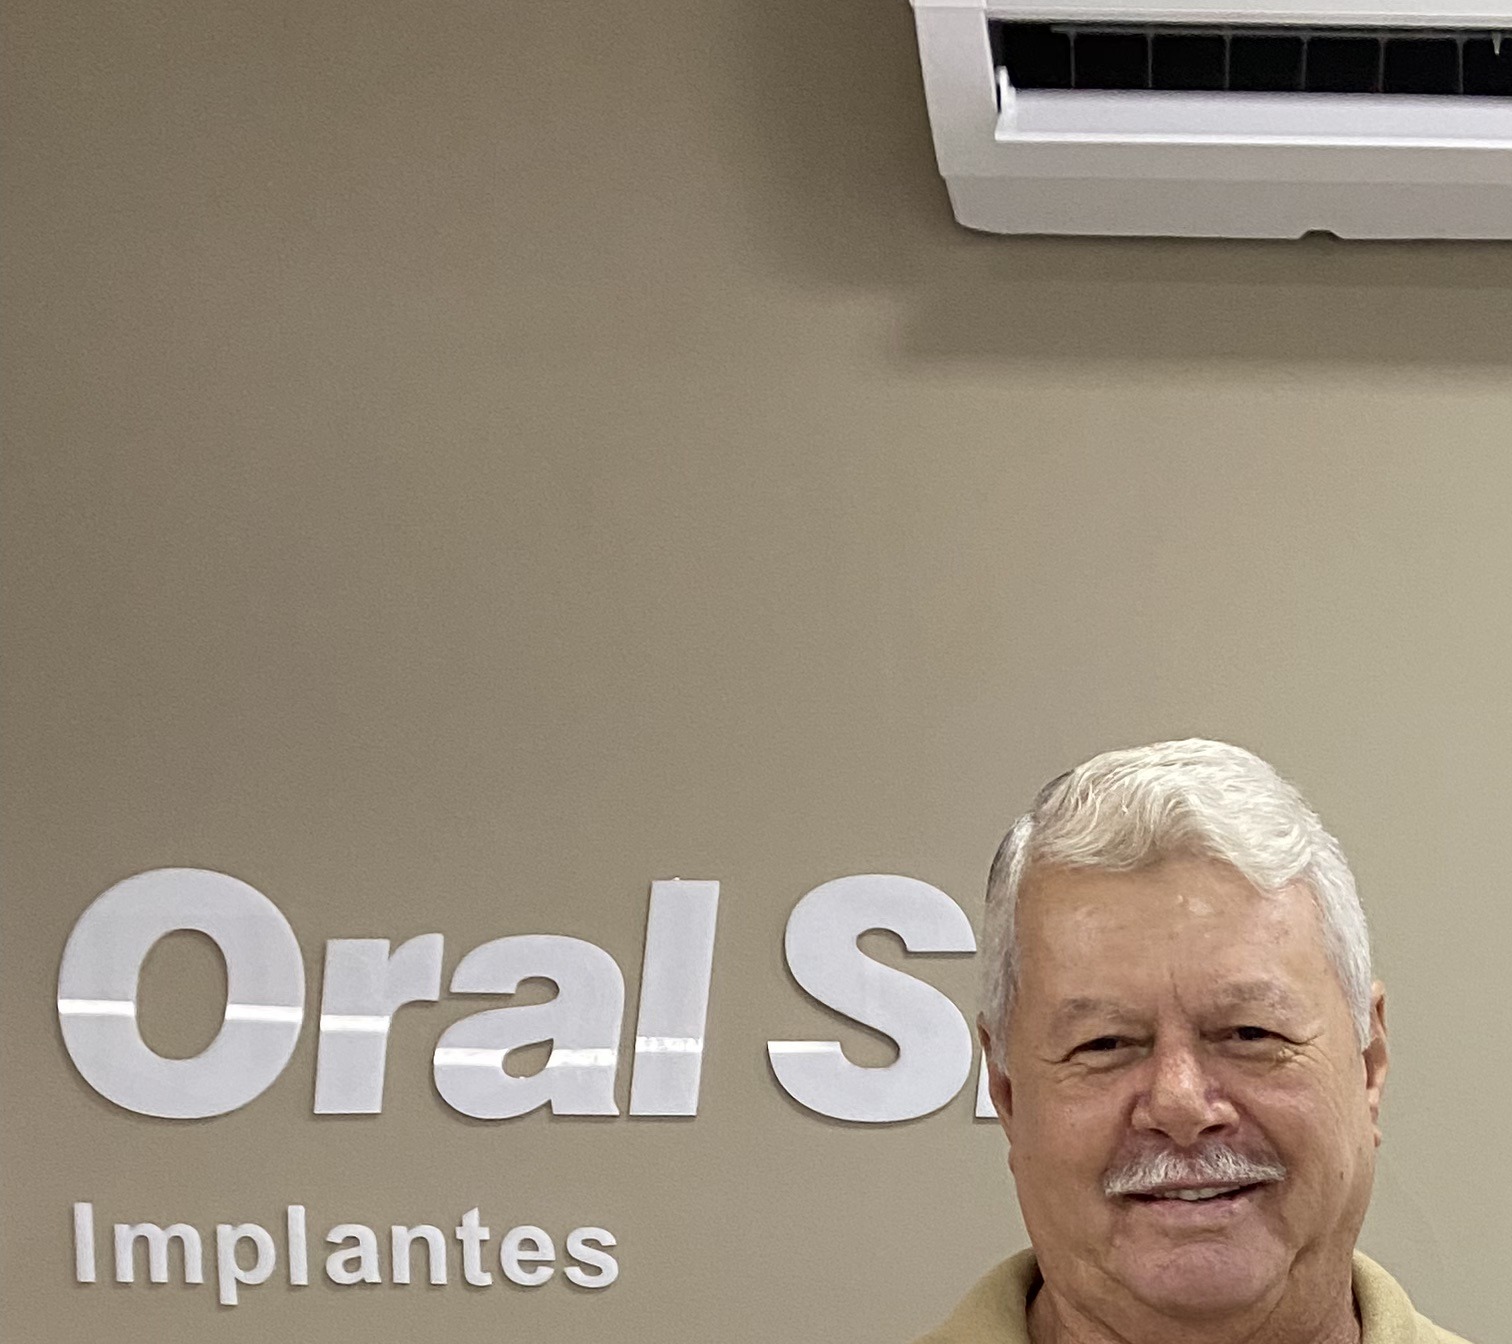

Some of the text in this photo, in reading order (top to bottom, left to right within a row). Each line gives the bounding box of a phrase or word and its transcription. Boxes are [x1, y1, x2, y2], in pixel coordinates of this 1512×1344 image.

[58, 867, 1002, 1124] Oral S
[74, 1202, 620, 1306] Implantes
